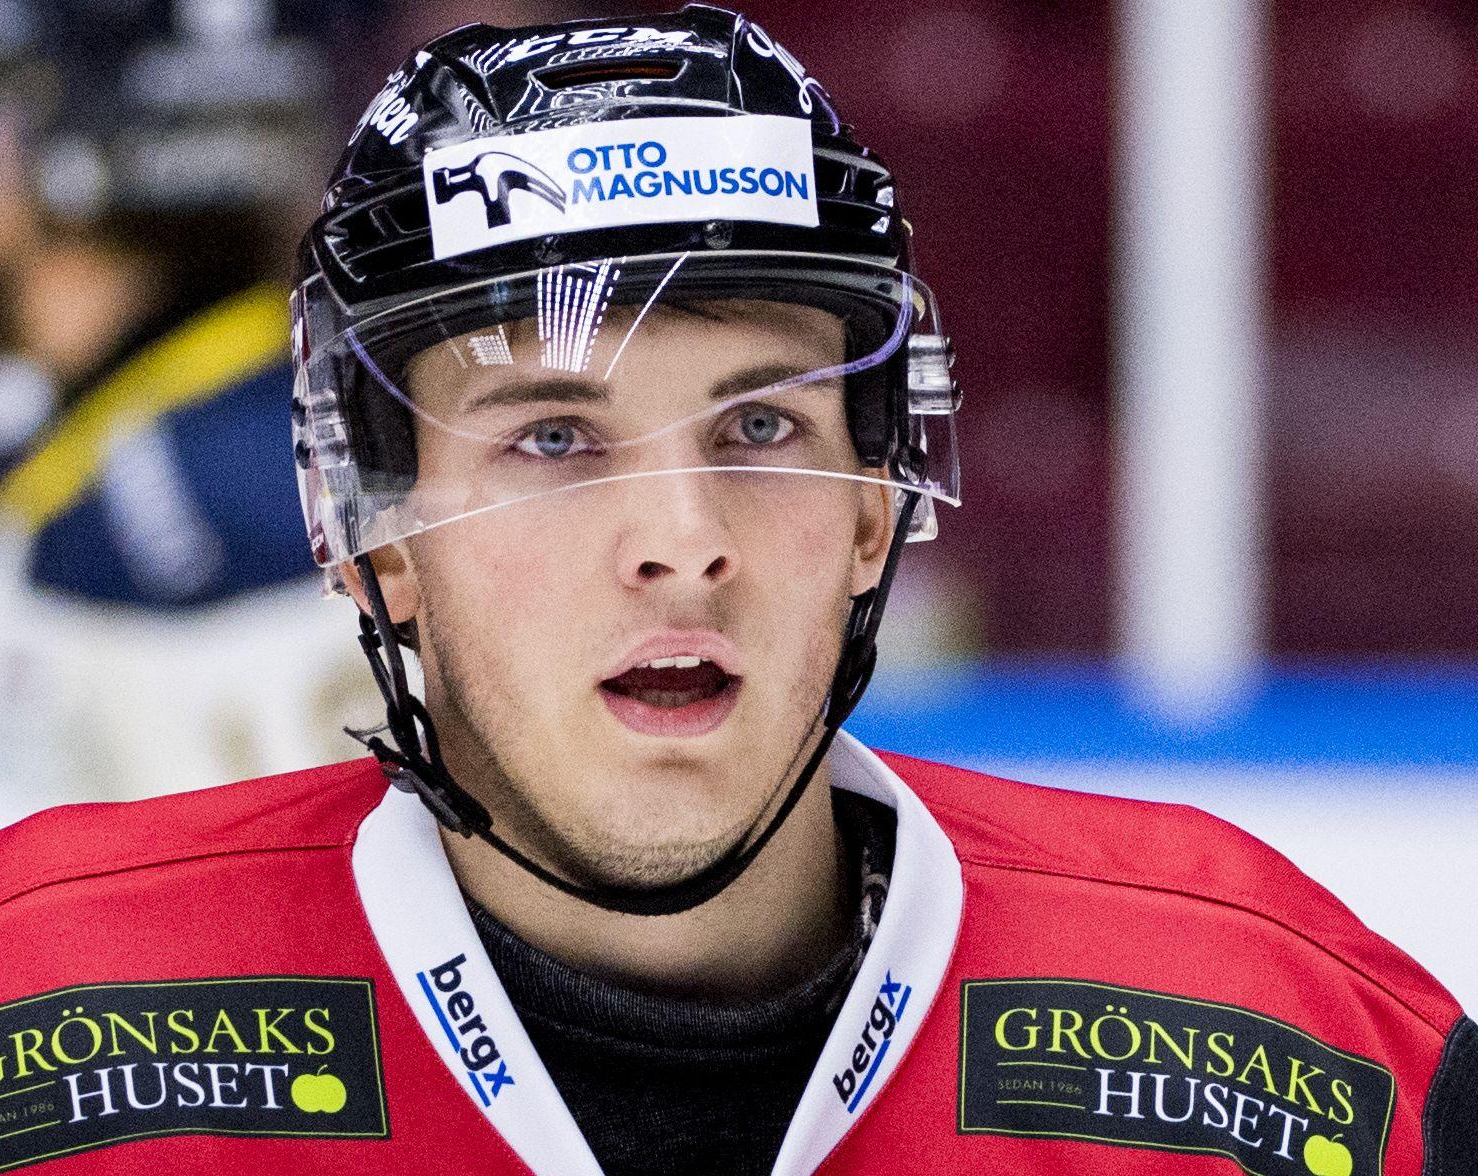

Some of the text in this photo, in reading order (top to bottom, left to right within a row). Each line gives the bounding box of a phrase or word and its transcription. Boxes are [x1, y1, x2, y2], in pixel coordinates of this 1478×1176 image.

[505, 26, 698, 62] CCM
[567, 140, 667, 175] OTTO
[572, 166, 809, 203] MAGNUSSON
[429, 953, 515, 1098] bergx
[833, 968, 901, 1104] bergx
[63, 1062, 290, 1124] HUSET
[995, 1005, 1355, 1125] GRÖNSAKS
[1093, 1067, 1308, 1160] HUSET
